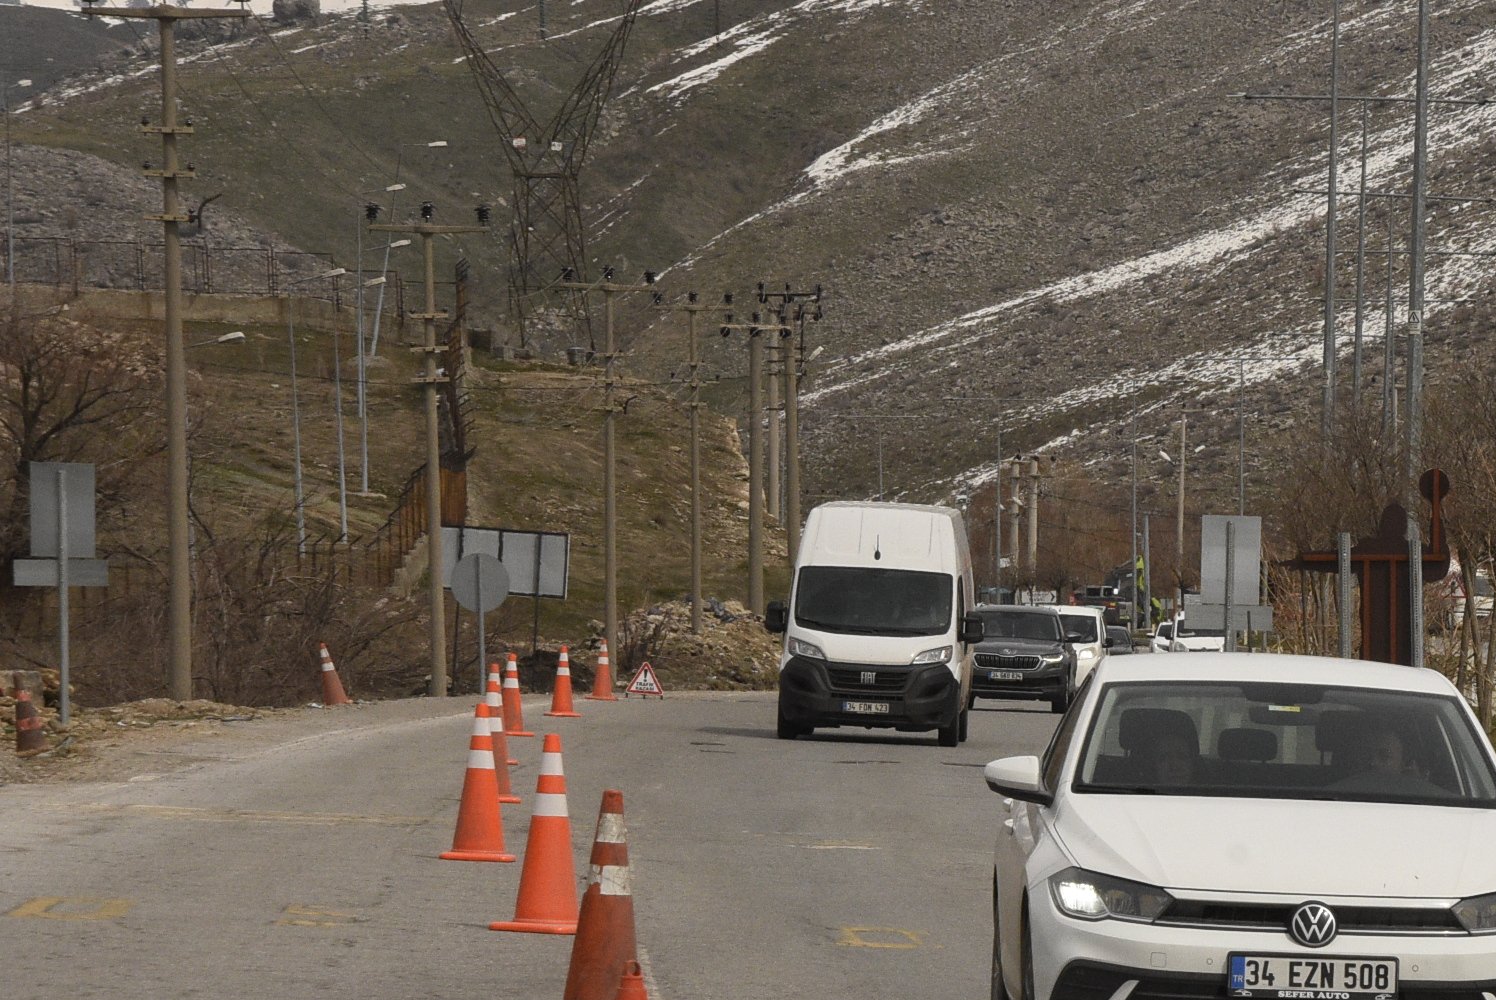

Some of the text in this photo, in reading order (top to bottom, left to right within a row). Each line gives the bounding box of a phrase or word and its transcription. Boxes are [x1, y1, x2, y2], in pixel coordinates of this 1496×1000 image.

[861, 671, 876, 685] FIAT
[847, 702, 856, 710] 34
[1232, 959, 1389, 990] TR 34 EZN 508
[1277, 990, 1350, 1000] SEFER AUTO
